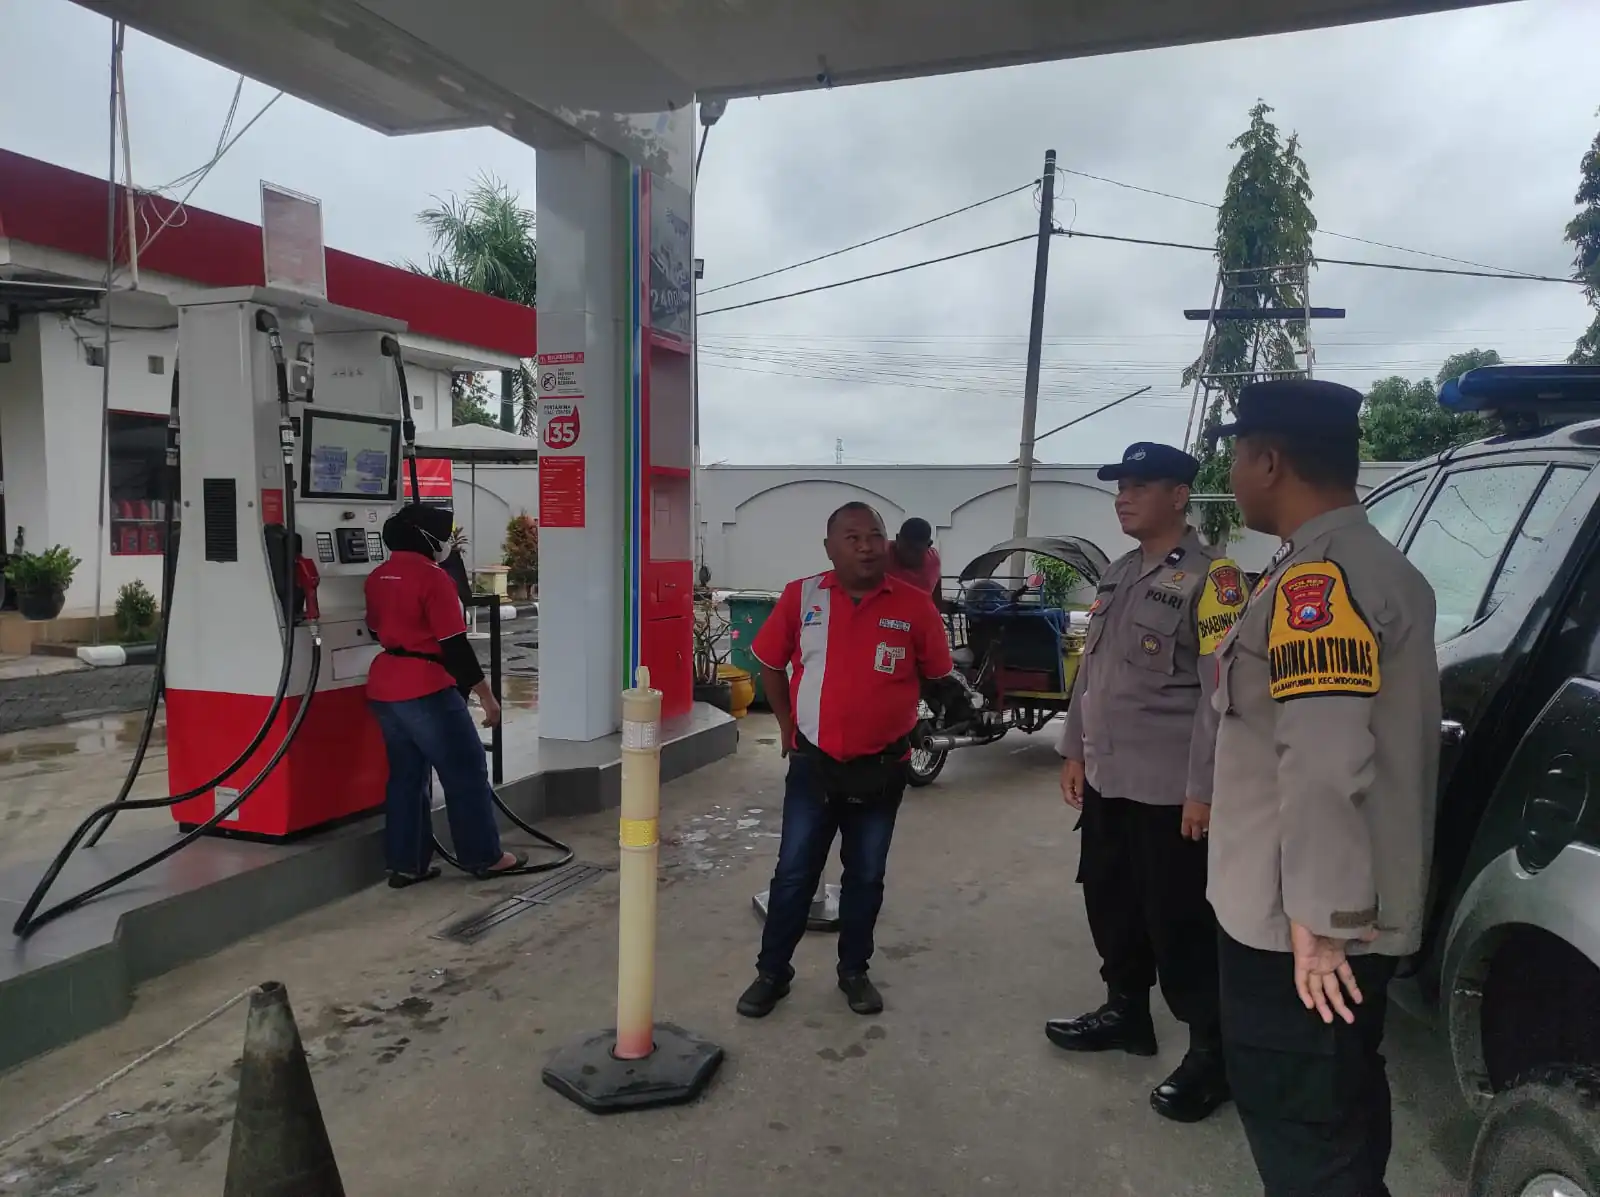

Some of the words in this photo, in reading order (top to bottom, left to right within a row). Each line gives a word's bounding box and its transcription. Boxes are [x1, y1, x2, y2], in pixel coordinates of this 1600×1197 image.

[545, 422, 575, 443] 135
[1144, 589, 1185, 610] POLRI
[1199, 612, 1240, 638] BHABINKA
